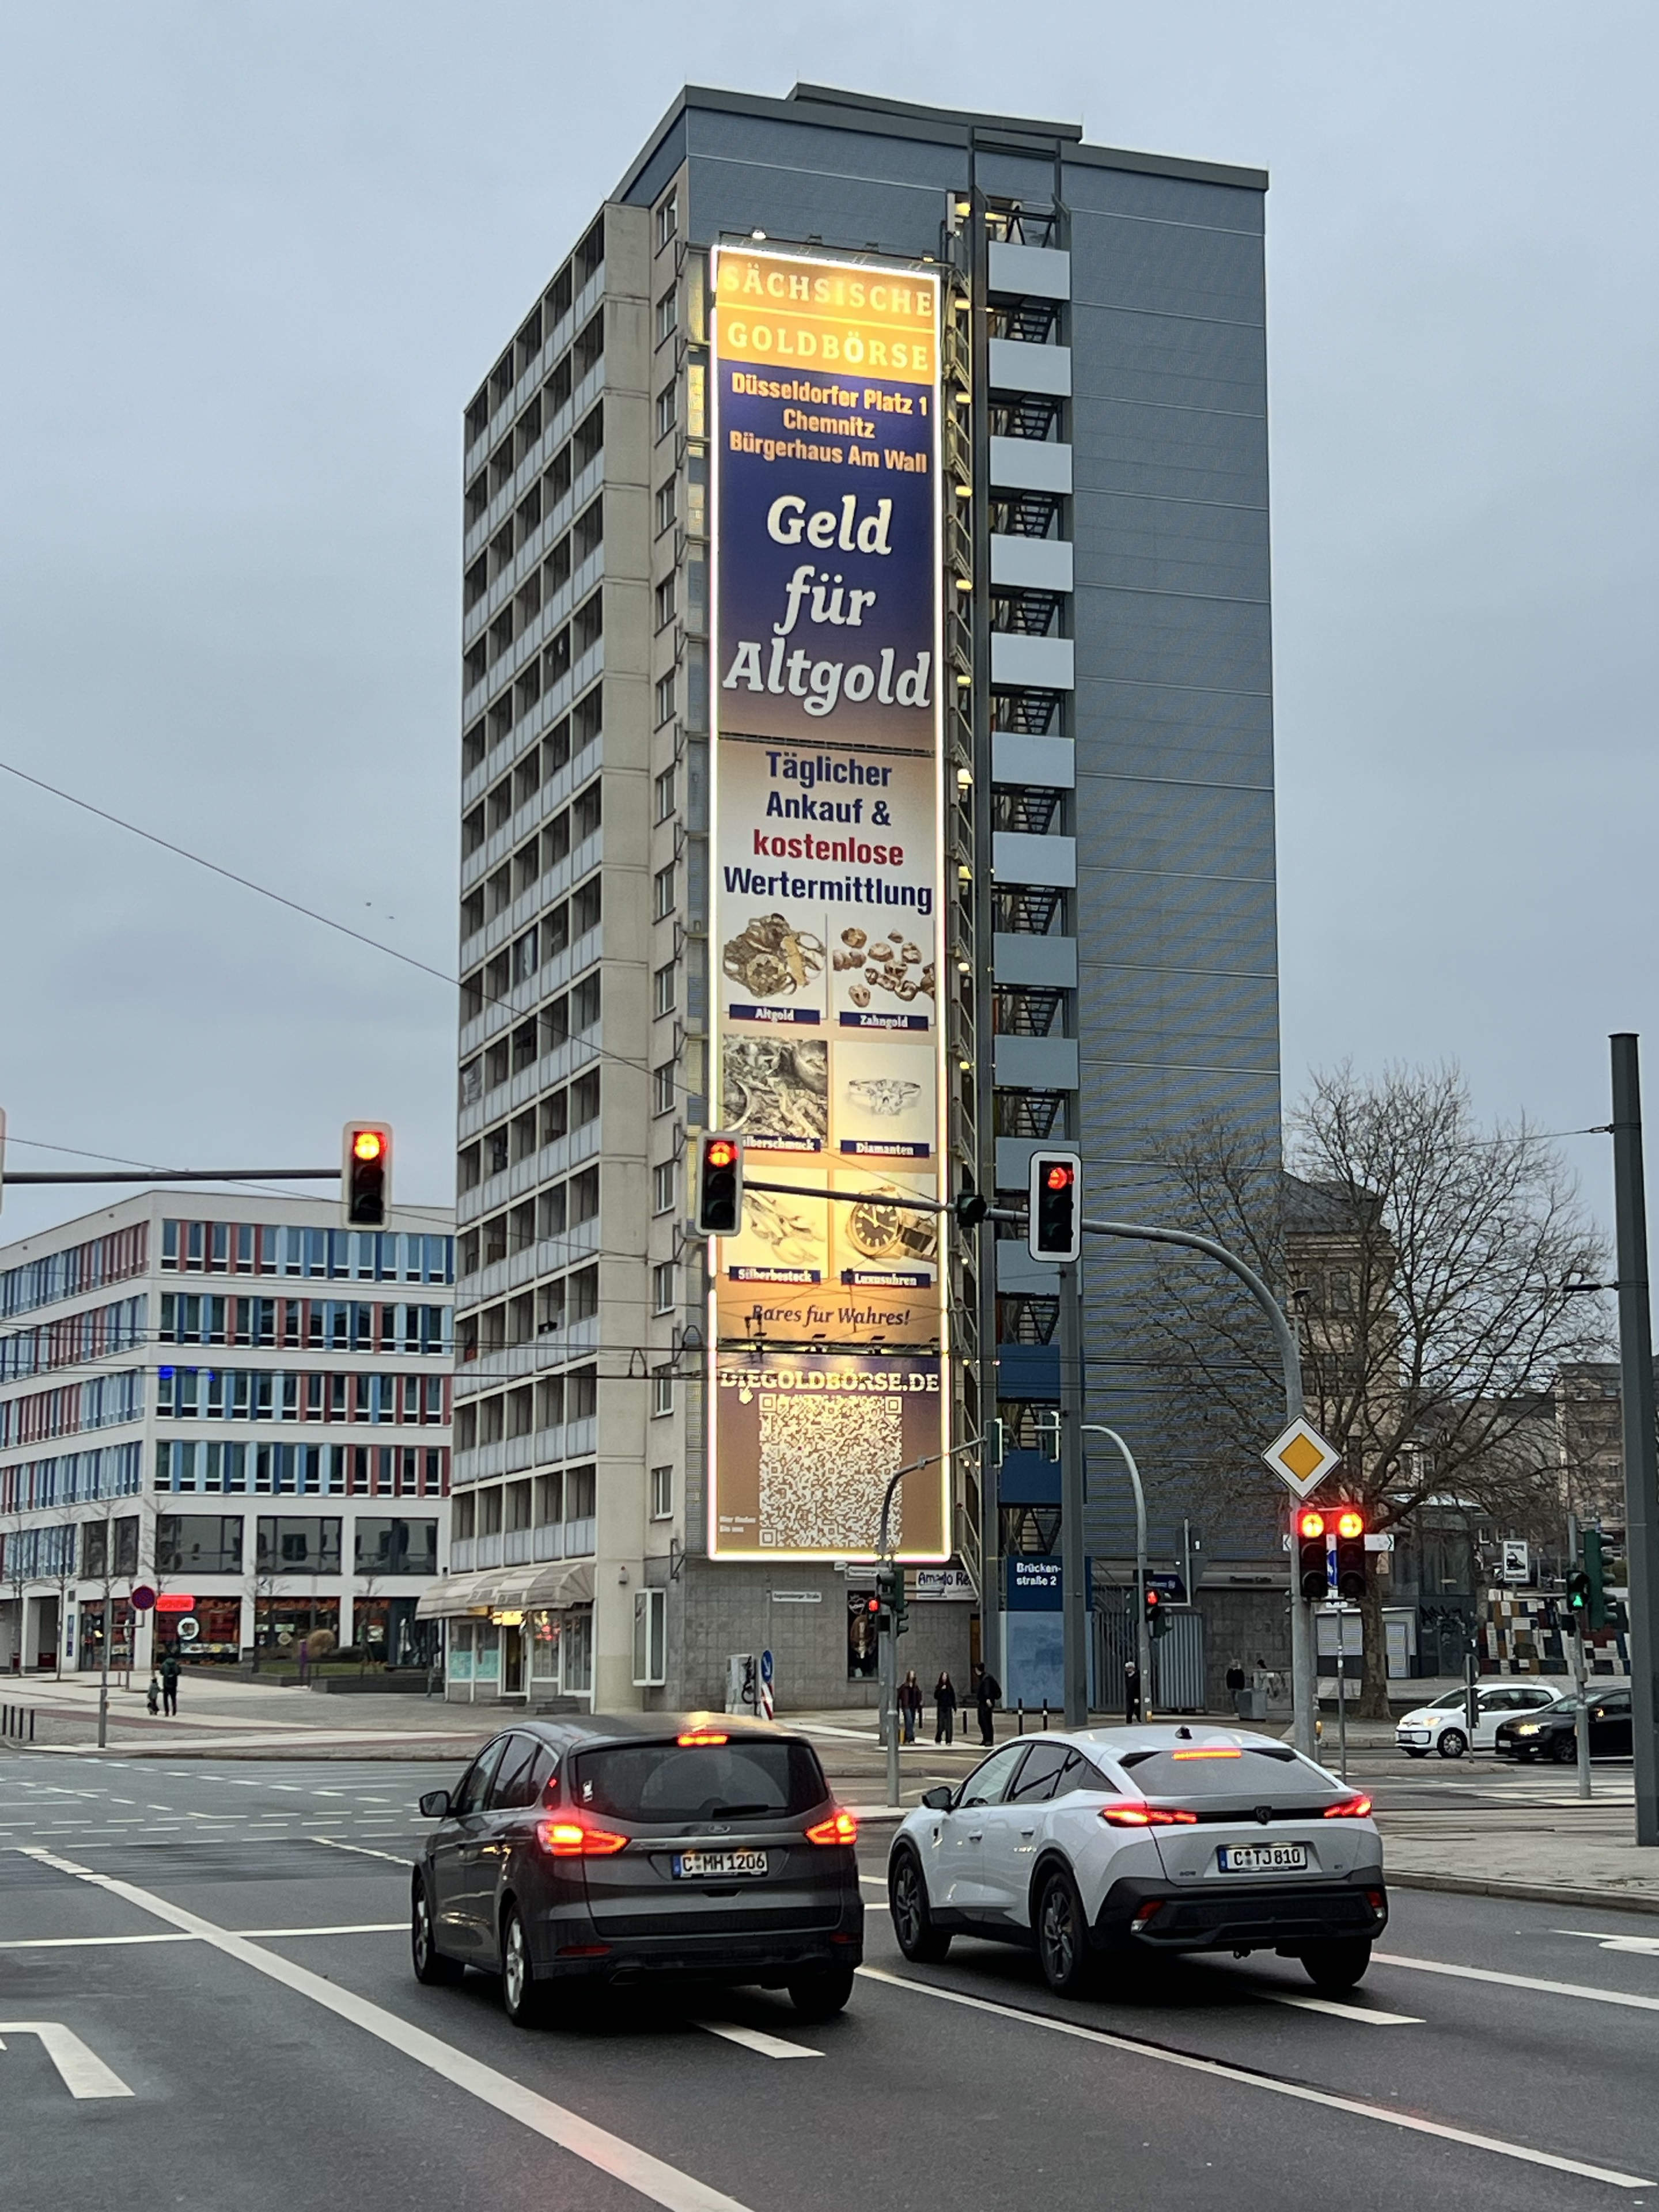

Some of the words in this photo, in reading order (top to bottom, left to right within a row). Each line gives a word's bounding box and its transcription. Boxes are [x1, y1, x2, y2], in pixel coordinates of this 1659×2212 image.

[721, 263, 933, 317] SÄCHSISCHE
[728, 321, 928, 370] GOLDBÖRSE
[732, 372, 858, 408] Düsseldorfer
[864, 389, 912, 415] Platz
[919, 396, 927, 416] 1
[783, 408, 876, 439] Chemnitz
[729, 430, 843, 464] Bürgerhaus
[848, 445, 879, 468] Am
[885, 449, 927, 474] Wall
[767, 494, 892, 555] Geld
[773, 565, 876, 635] für
[722, 637, 931, 717] Altgold
[766, 751, 892, 789] Täglicher
[766, 791, 863, 824] Ankauf
[871, 800, 892, 826] &
[753, 828, 904, 866] kostenlose
[724, 866, 933, 915] Wertermittlung
[755, 1008, 794, 1022] Altgold
[859, 1014, 908, 1029] Zahngold
[856, 1142, 914, 1156] Diamanten
[738, 1268, 812, 1283] Silberbesteck
[854, 1273, 917, 1287] Luxusuhren
[838, 1306, 910, 1325] Wahres!
[720, 1368, 940, 1392] DIEGOLDBÖRSE.DE
[1016, 1562, 1061, 1573] Brücken-
[1016, 1575, 1048, 1585] straße
[1050, 1575, 1056, 1586] 2
[683, 1856, 692, 1872] C
[703, 1854, 724, 1872] MH
[727, 1853, 765, 1870] 1206
[1234, 1851, 1243, 1866] C
[1253, 1849, 1272, 1865] TJ
[1274, 1848, 1300, 1864] 810
